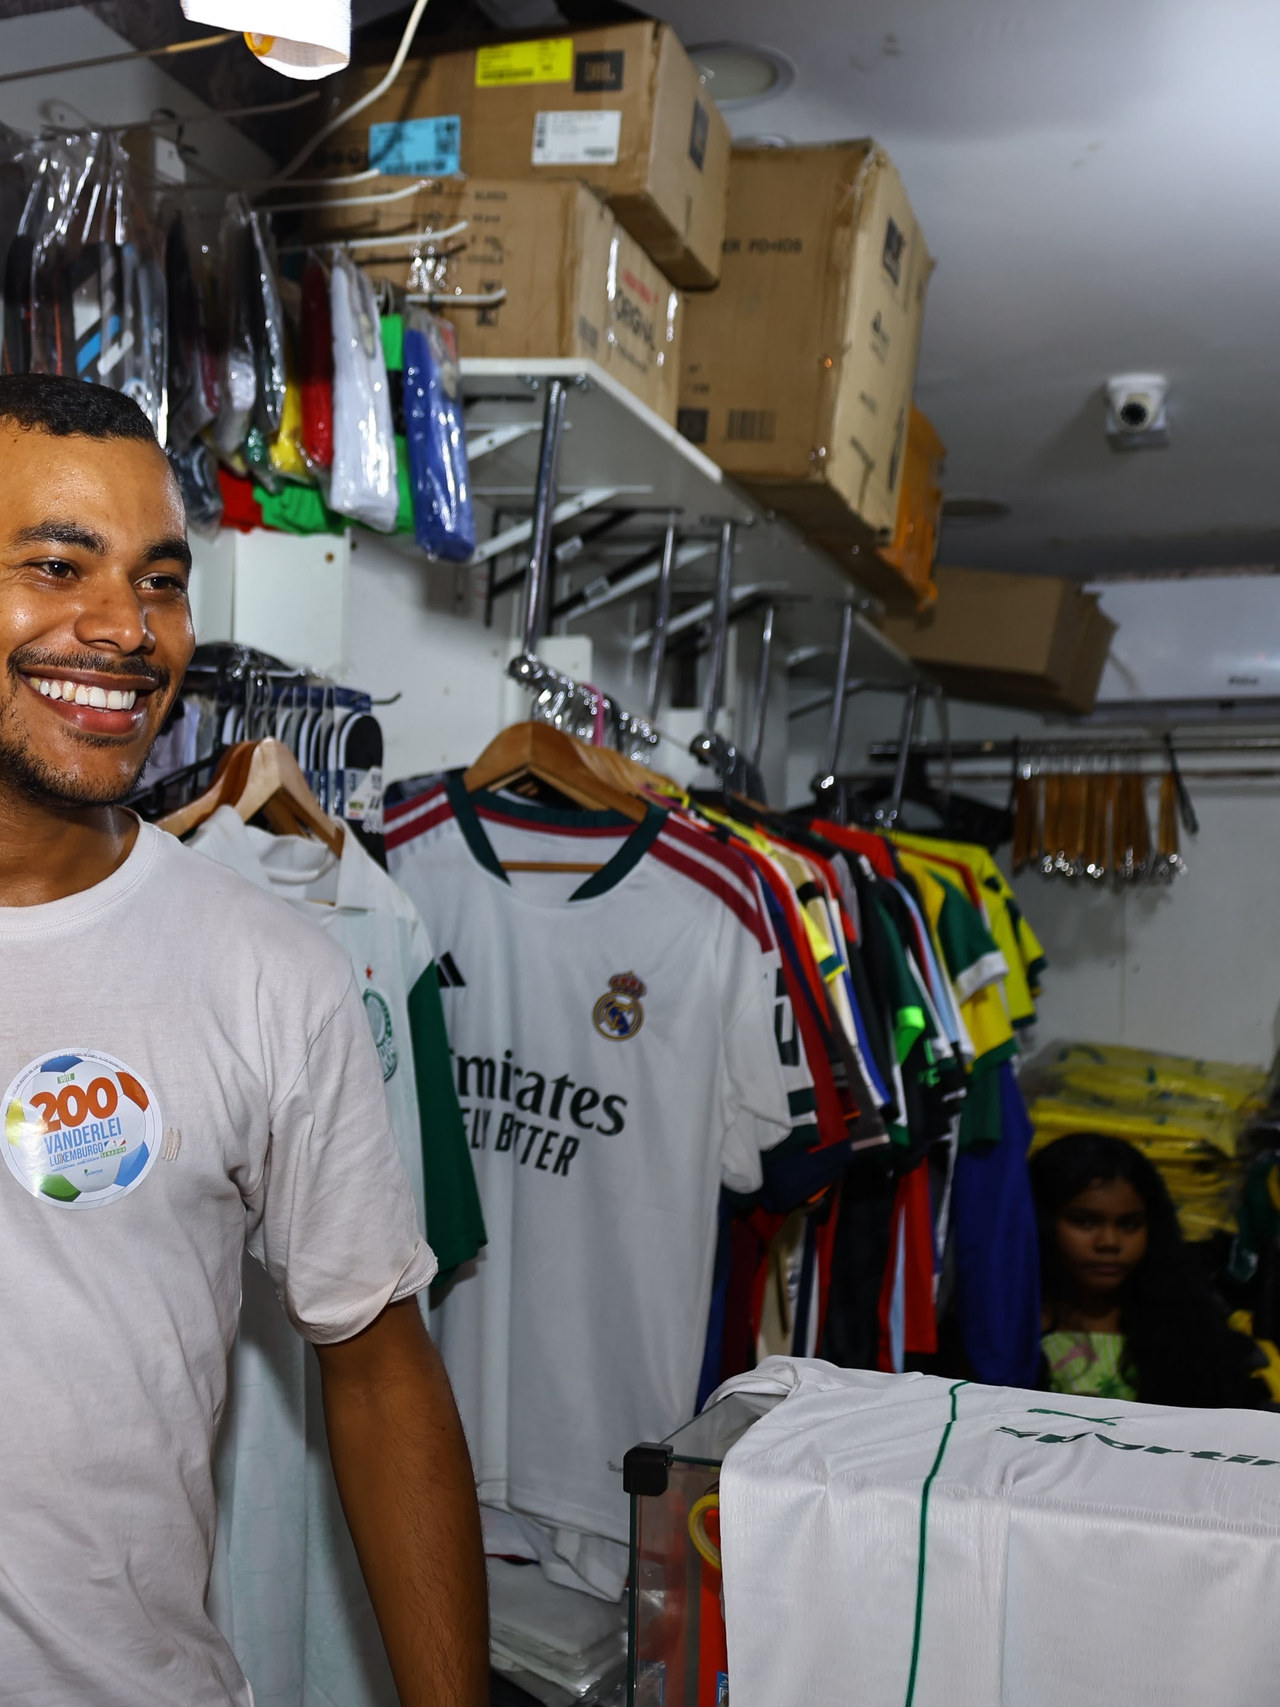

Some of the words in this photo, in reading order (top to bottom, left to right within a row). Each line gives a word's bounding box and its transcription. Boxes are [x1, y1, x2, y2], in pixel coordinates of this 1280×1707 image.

[29, 1077, 118, 1135] 200
[450, 1048, 628, 1137] mirates
[43, 1117, 122, 1154] VANDERLEI
[49, 1142, 104, 1167] LUXEMBURGO
